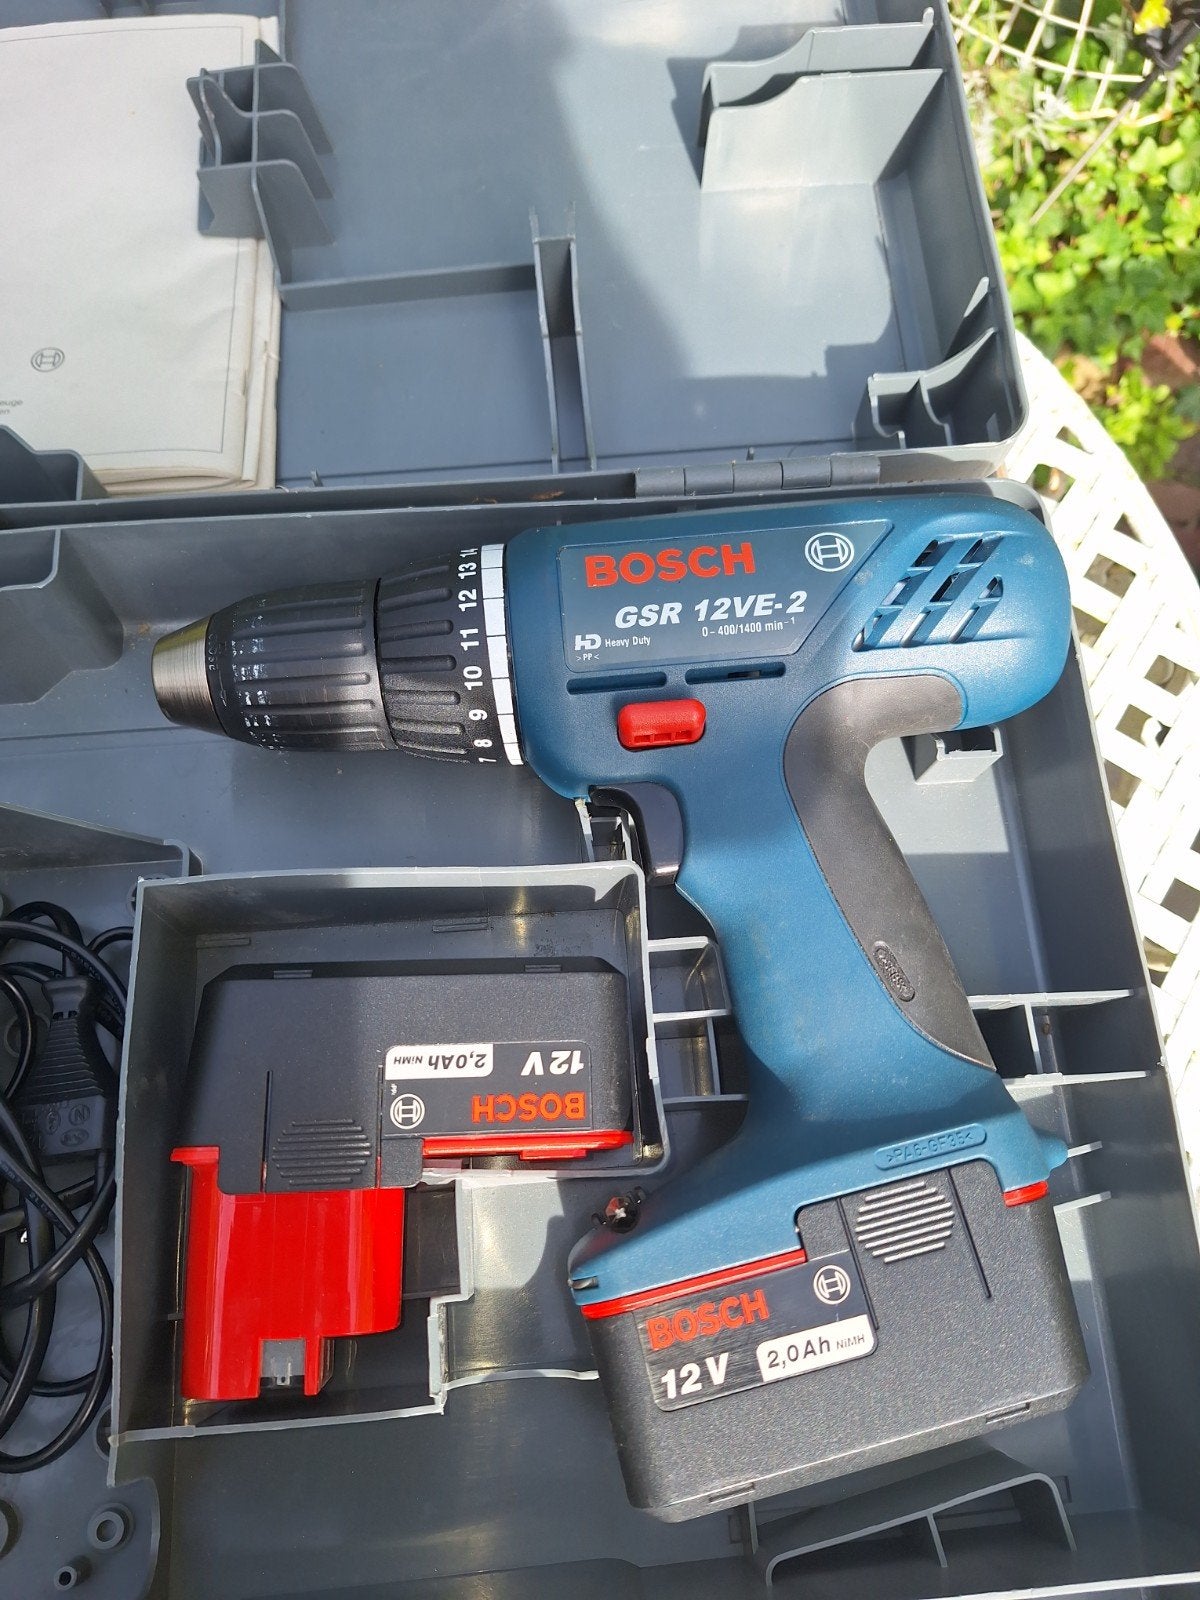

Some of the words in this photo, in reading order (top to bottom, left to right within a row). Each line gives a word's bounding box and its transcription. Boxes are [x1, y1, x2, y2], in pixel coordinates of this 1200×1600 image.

[458, 562, 477, 579] 13
[584, 542, 756, 588] BOSCH
[458, 588, 477, 611] 12
[615, 602, 682, 629] GSR
[694, 590, 808, 622] 12VE-2
[460, 628, 479, 651] 11
[575, 633, 602, 651] HD
[605, 638, 630, 648] Heavy
[632, 635, 651, 646] Duty
[463, 665, 483, 690] 10
[469, 709, 488, 721] 9
[473, 738, 493, 748] 8
[393, 1055, 423, 1065] NiMH
[471, 1091, 586, 1123] BOSCH
[645, 1289, 770, 1350] BOSCH
[836, 1334, 865, 1350] NiMH
